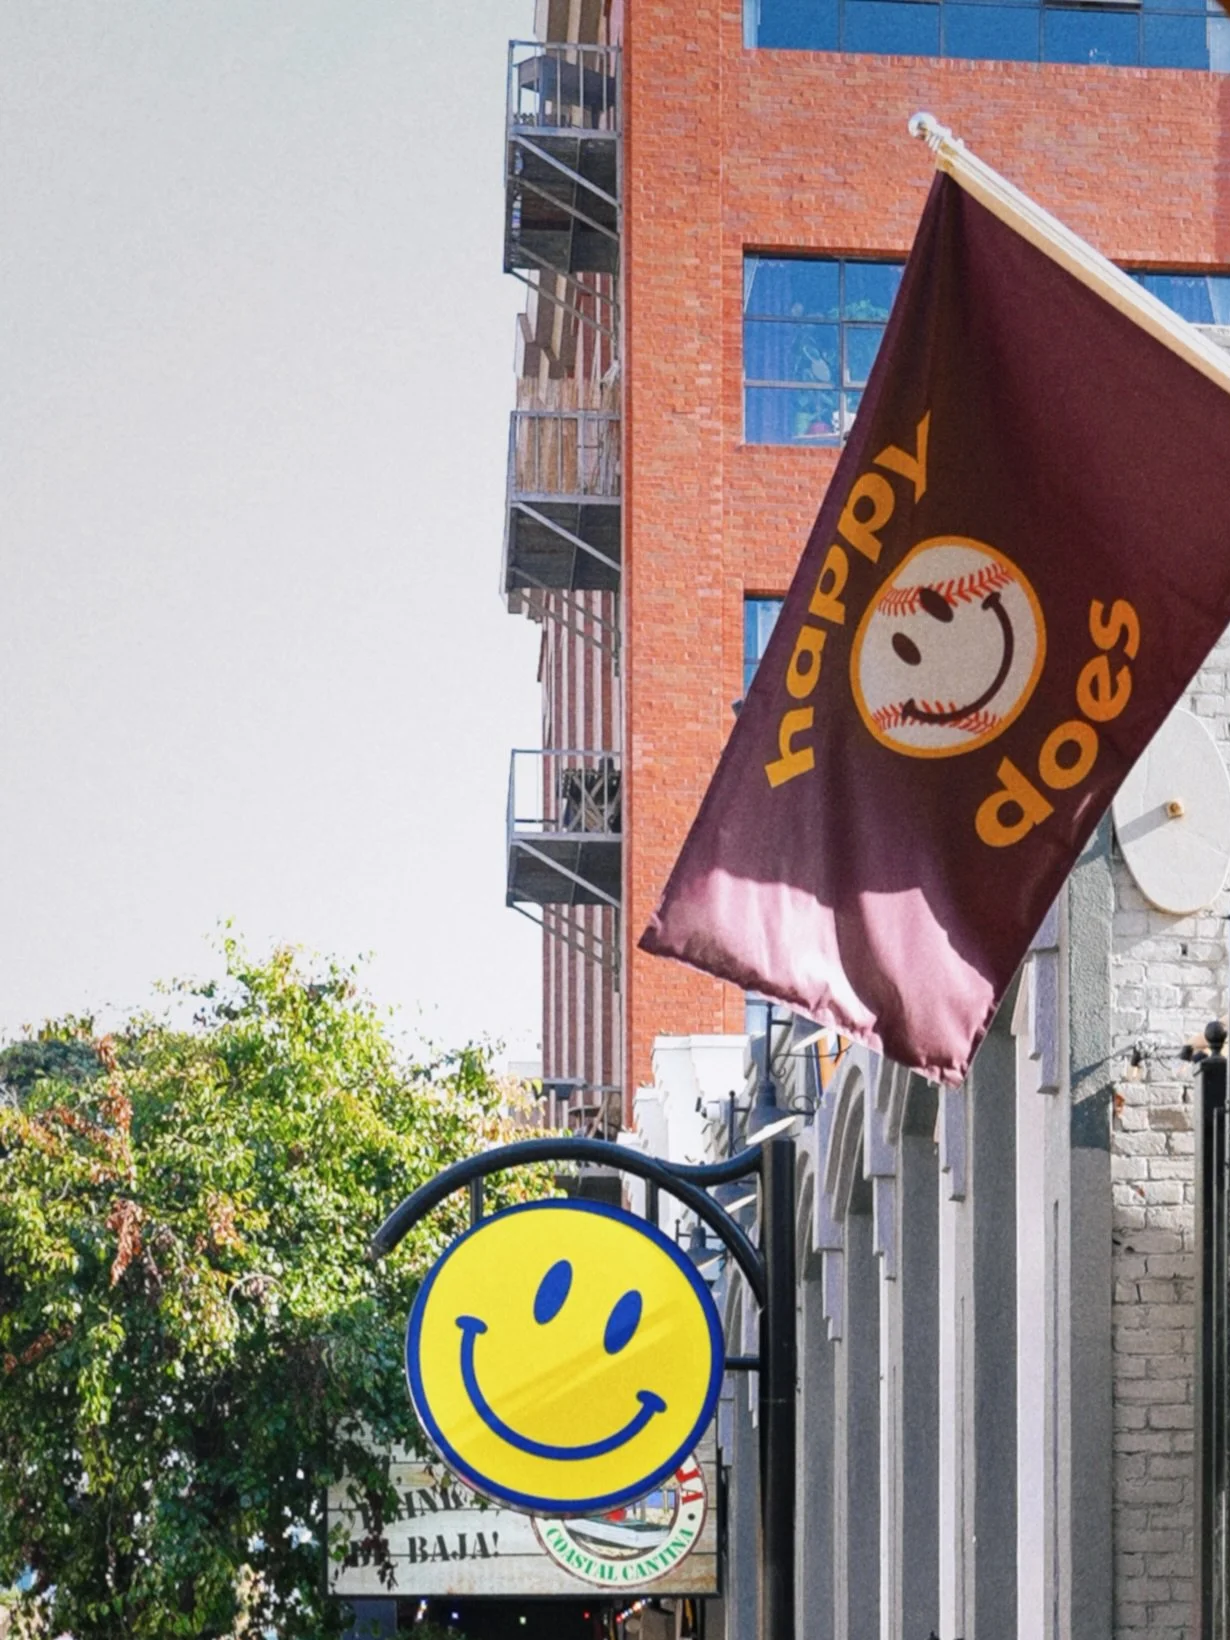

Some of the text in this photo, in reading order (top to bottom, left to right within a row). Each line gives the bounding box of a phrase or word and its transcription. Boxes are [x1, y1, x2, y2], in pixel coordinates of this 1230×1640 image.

[764, 411, 931, 787] happy
[975, 599, 1139, 847] does
[407, 1531, 498, 1564] BAJA!
[545, 1526, 694, 1581] COASTAL CANTINA
